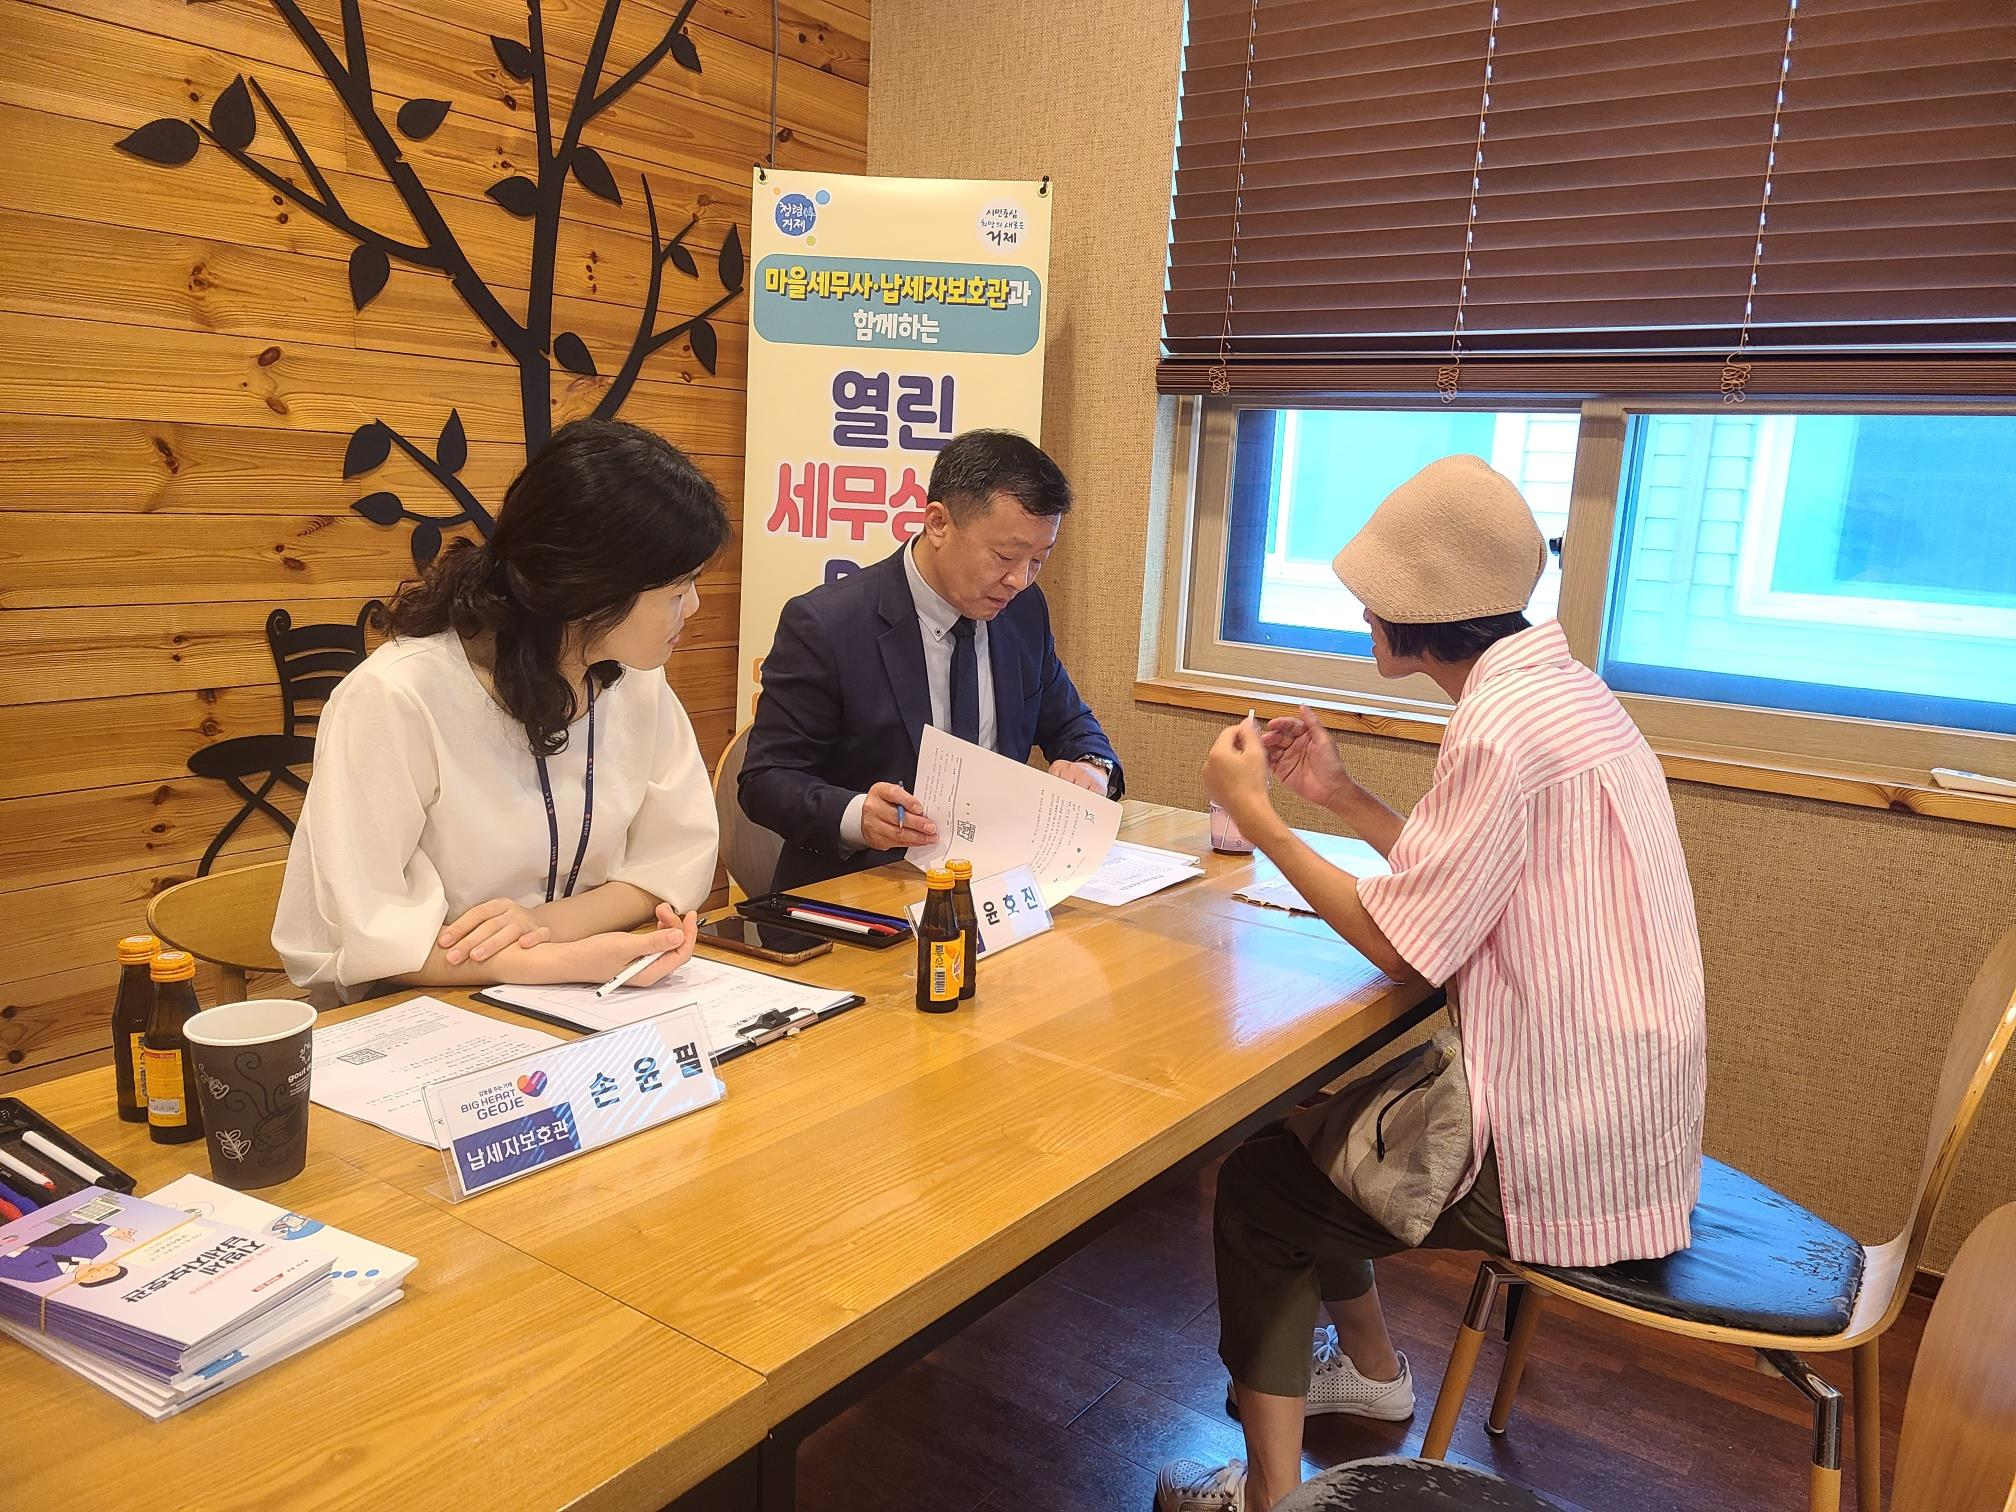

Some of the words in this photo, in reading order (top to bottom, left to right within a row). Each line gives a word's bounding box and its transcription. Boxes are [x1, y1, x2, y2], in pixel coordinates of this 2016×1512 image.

[781, 217, 806, 233] 거제
[986, 208, 1018, 219] 시민중심
[986, 229, 1017, 246] 거제
[853, 308, 940, 344] 함께하는
[832, 370, 955, 451] 열린
[1002, 894, 1020, 918] 호
[1020, 886, 1038, 910] 진
[589, 1071, 620, 1109] 손
[633, 1056, 662, 1093] 윤
[461, 1100, 480, 1114] BIG
[481, 1089, 516, 1109] HEART
[477, 1096, 525, 1121] GEOJE
[466, 1119, 570, 1172] 납세자보호관
[120, 1236, 250, 1304] 납세자보호관
